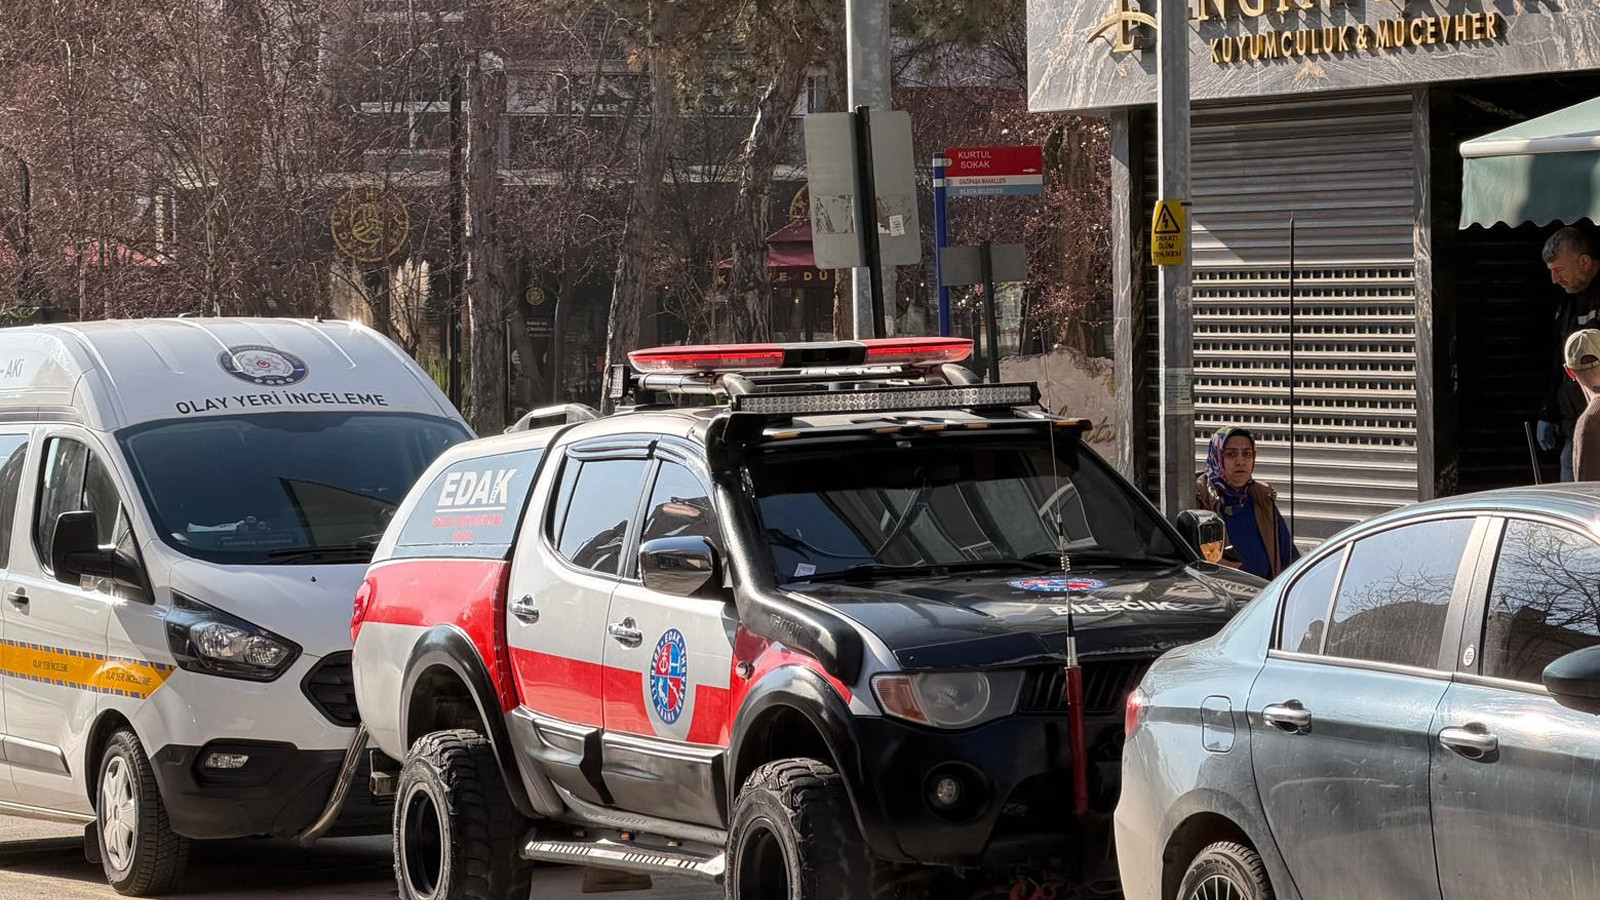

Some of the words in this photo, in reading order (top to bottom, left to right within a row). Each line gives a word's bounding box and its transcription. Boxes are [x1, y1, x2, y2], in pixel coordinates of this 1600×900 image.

[1209, 25, 1350, 63] KUYUMCULUK
[1356, 24, 1368, 49] &
[1375, 11, 1497, 48] MÜCEVHER
[957, 150, 992, 159] KURTUL
[960, 160, 990, 169] SOKAK
[176, 396, 229, 414] OLAY
[232, 391, 281, 408] YERİ
[282, 390, 389, 407] İNCELEME
[437, 468, 518, 506] EDAK
